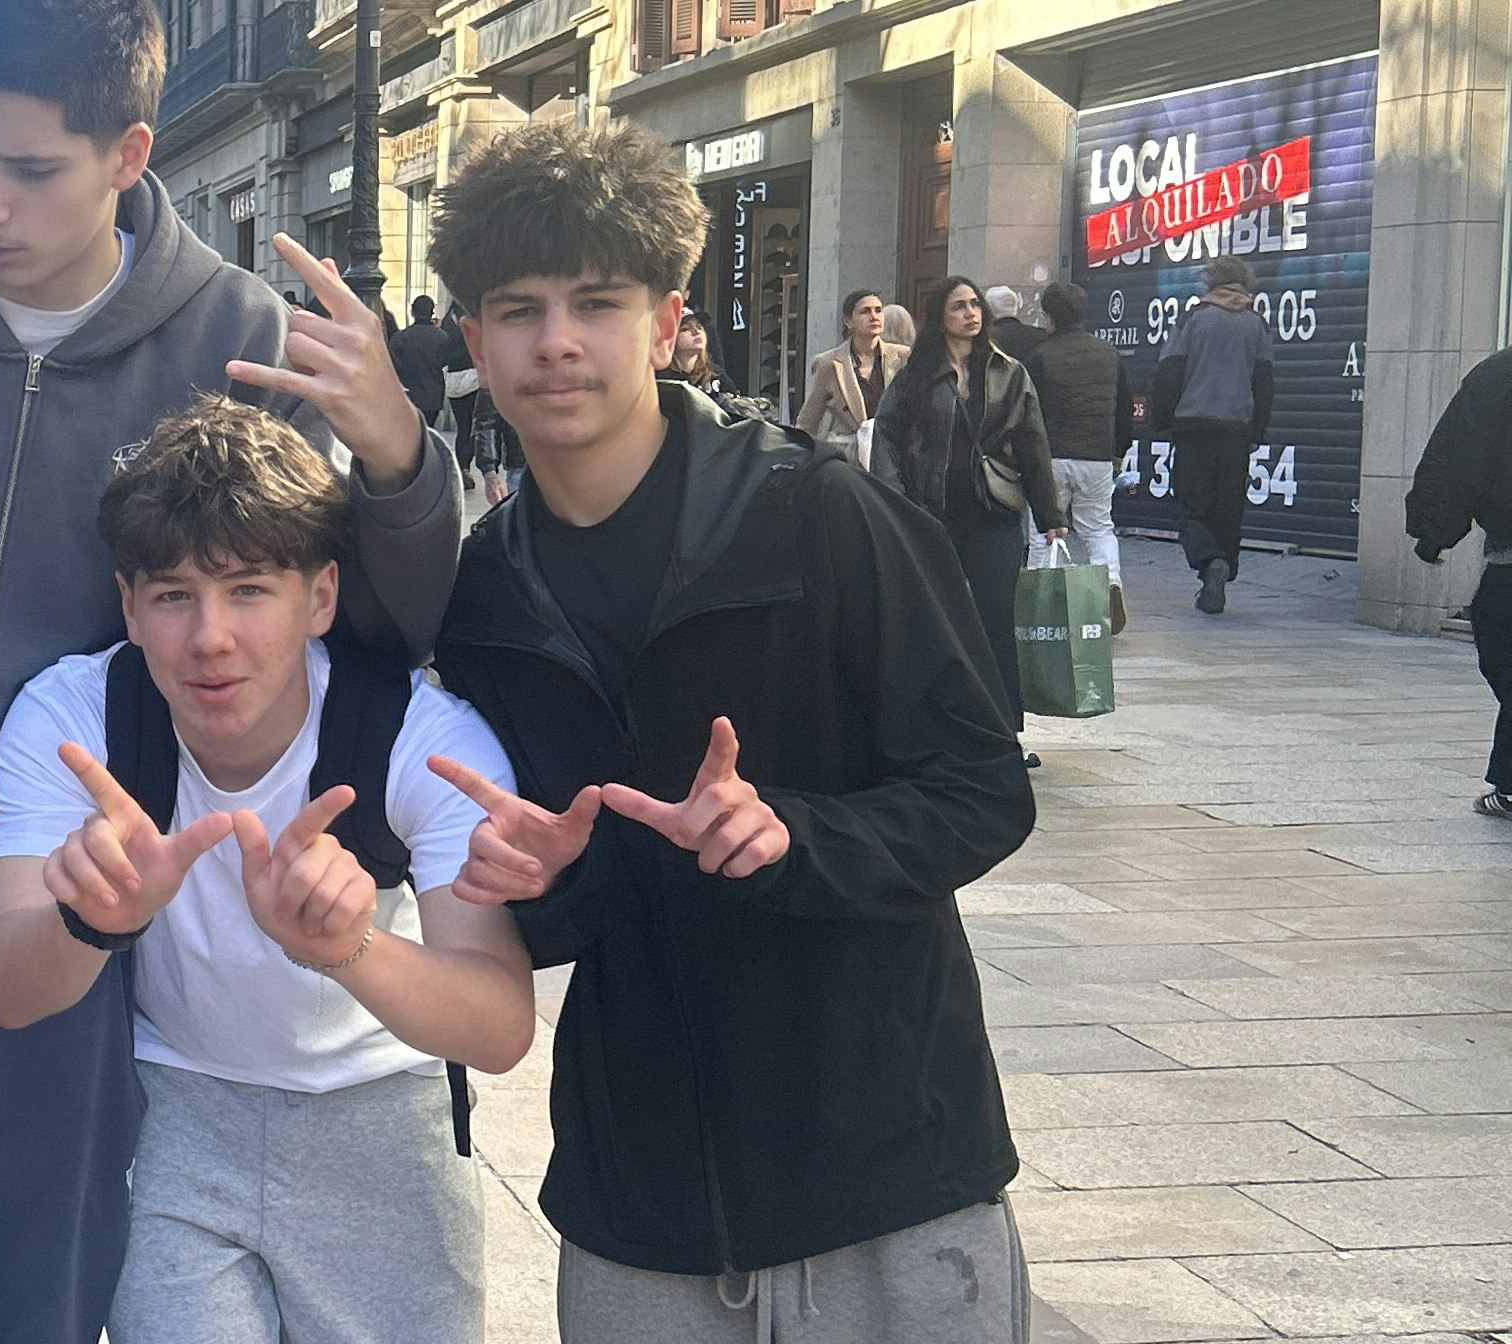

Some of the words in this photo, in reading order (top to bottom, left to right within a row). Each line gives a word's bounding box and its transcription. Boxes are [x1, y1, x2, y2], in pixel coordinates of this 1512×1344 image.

[1089, 132, 1207, 205] LOCAL
[1104, 153, 1283, 250] ALQUILADO
[1278, 289, 1317, 342] 05
[1148, 441, 1176, 498] 3
